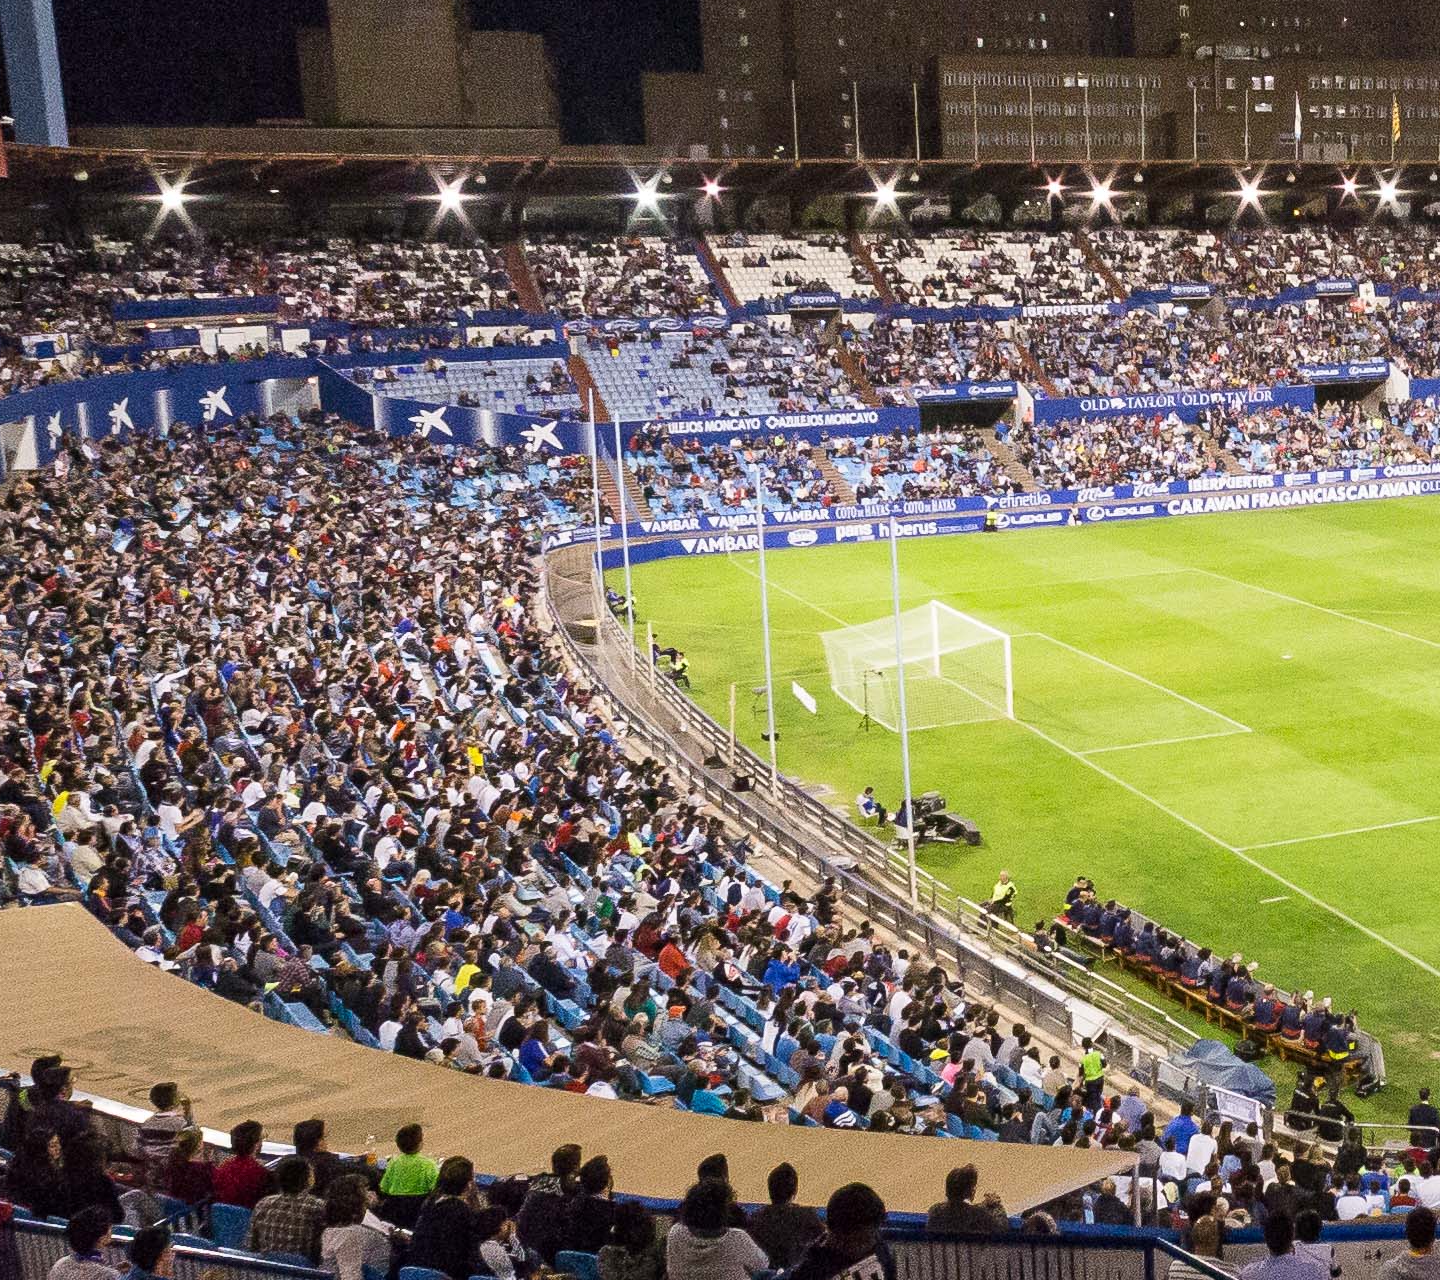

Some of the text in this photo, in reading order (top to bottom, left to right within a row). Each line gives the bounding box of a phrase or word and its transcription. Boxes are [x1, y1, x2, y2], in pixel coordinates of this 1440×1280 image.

[803, 295, 837, 305] TOYOTA
[1080, 389, 1273, 412] OLD TAYLOR OLD TAYLOR
[705, 418, 761, 433] MONCAYO
[778, 411, 879, 429] AZULEJOS MONCAYO
[1188, 474, 1274, 492] IBERPUERTAS
[1167, 480, 1420, 515] CARAVAN FRAGANCIAS CARAVAN
[716, 512, 766, 528] AMBAR
[780, 507, 831, 522] AMBAR
[836, 506, 857, 519] COTO
[651, 517, 701, 533] AMBAR
[879, 522, 937, 538] hberus
[694, 534, 760, 553] AMBAR
